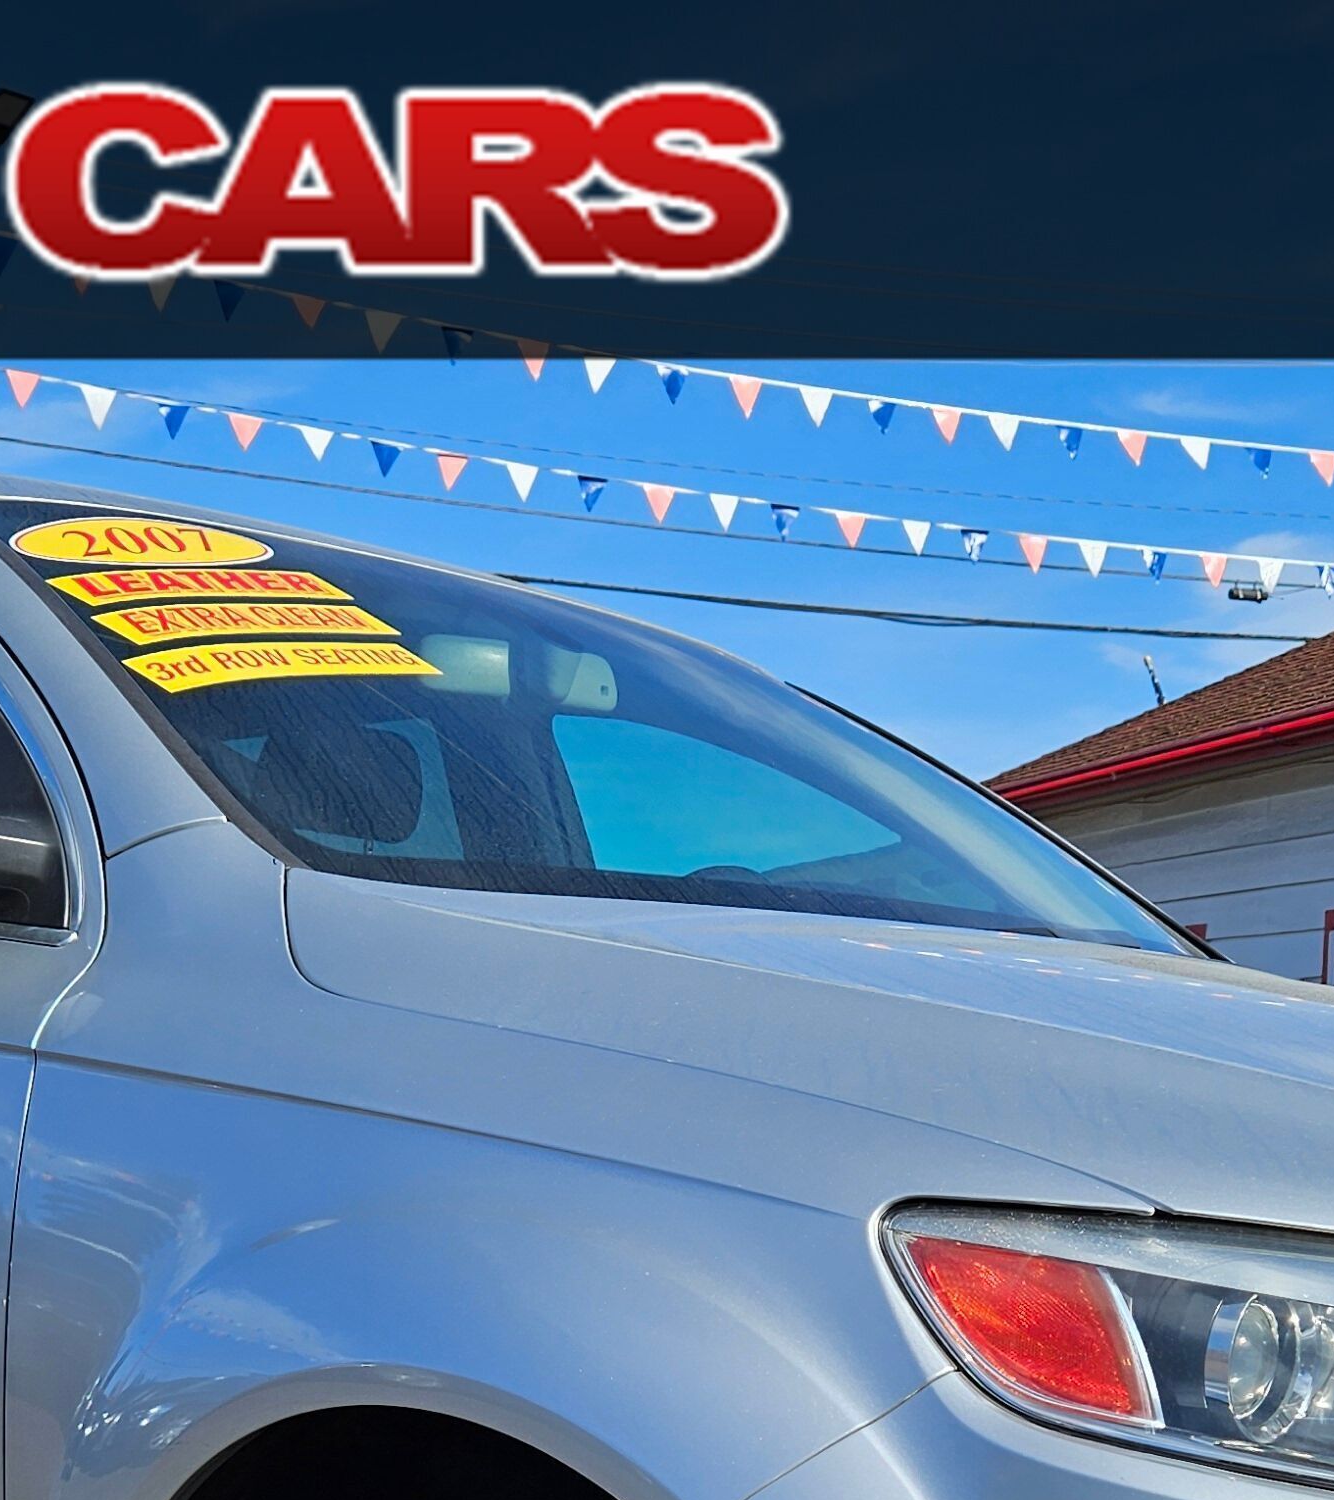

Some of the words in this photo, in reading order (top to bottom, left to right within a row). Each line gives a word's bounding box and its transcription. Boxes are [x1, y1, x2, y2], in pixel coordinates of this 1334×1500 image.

[61, 525, 213, 557] 2007
[75, 569, 323, 599] LEATHER
[121, 606, 257, 635] EXTRA
[260, 605, 370, 631] CLEAN
[146, 654, 212, 682] 3rd
[213, 648, 291, 671] ROW
[294, 647, 417, 668] SEATING
